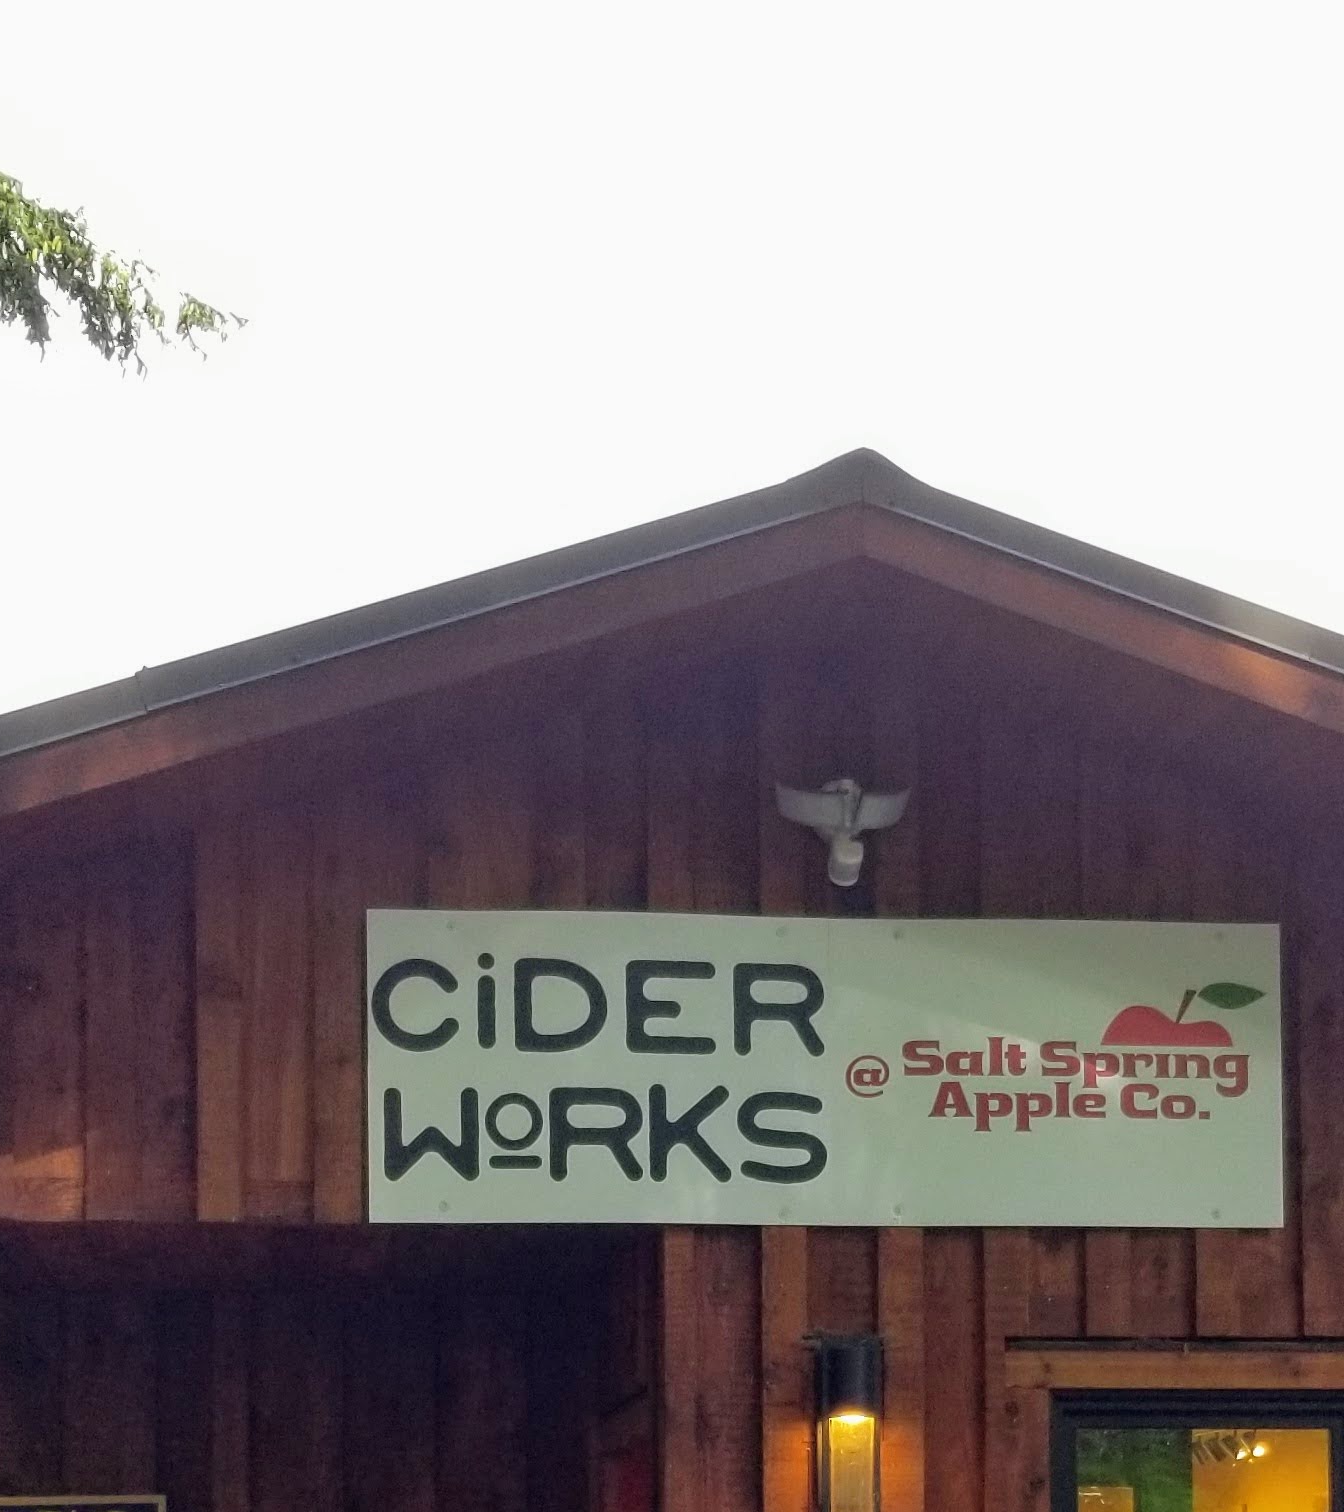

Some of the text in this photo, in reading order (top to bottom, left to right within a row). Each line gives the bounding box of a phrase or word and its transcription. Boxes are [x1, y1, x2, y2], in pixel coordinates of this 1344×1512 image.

[901, 1036, 1027, 1077] Salt
[1040, 1040, 1251, 1098] Spring
[928, 1081, 1211, 1132] Apple Co.
